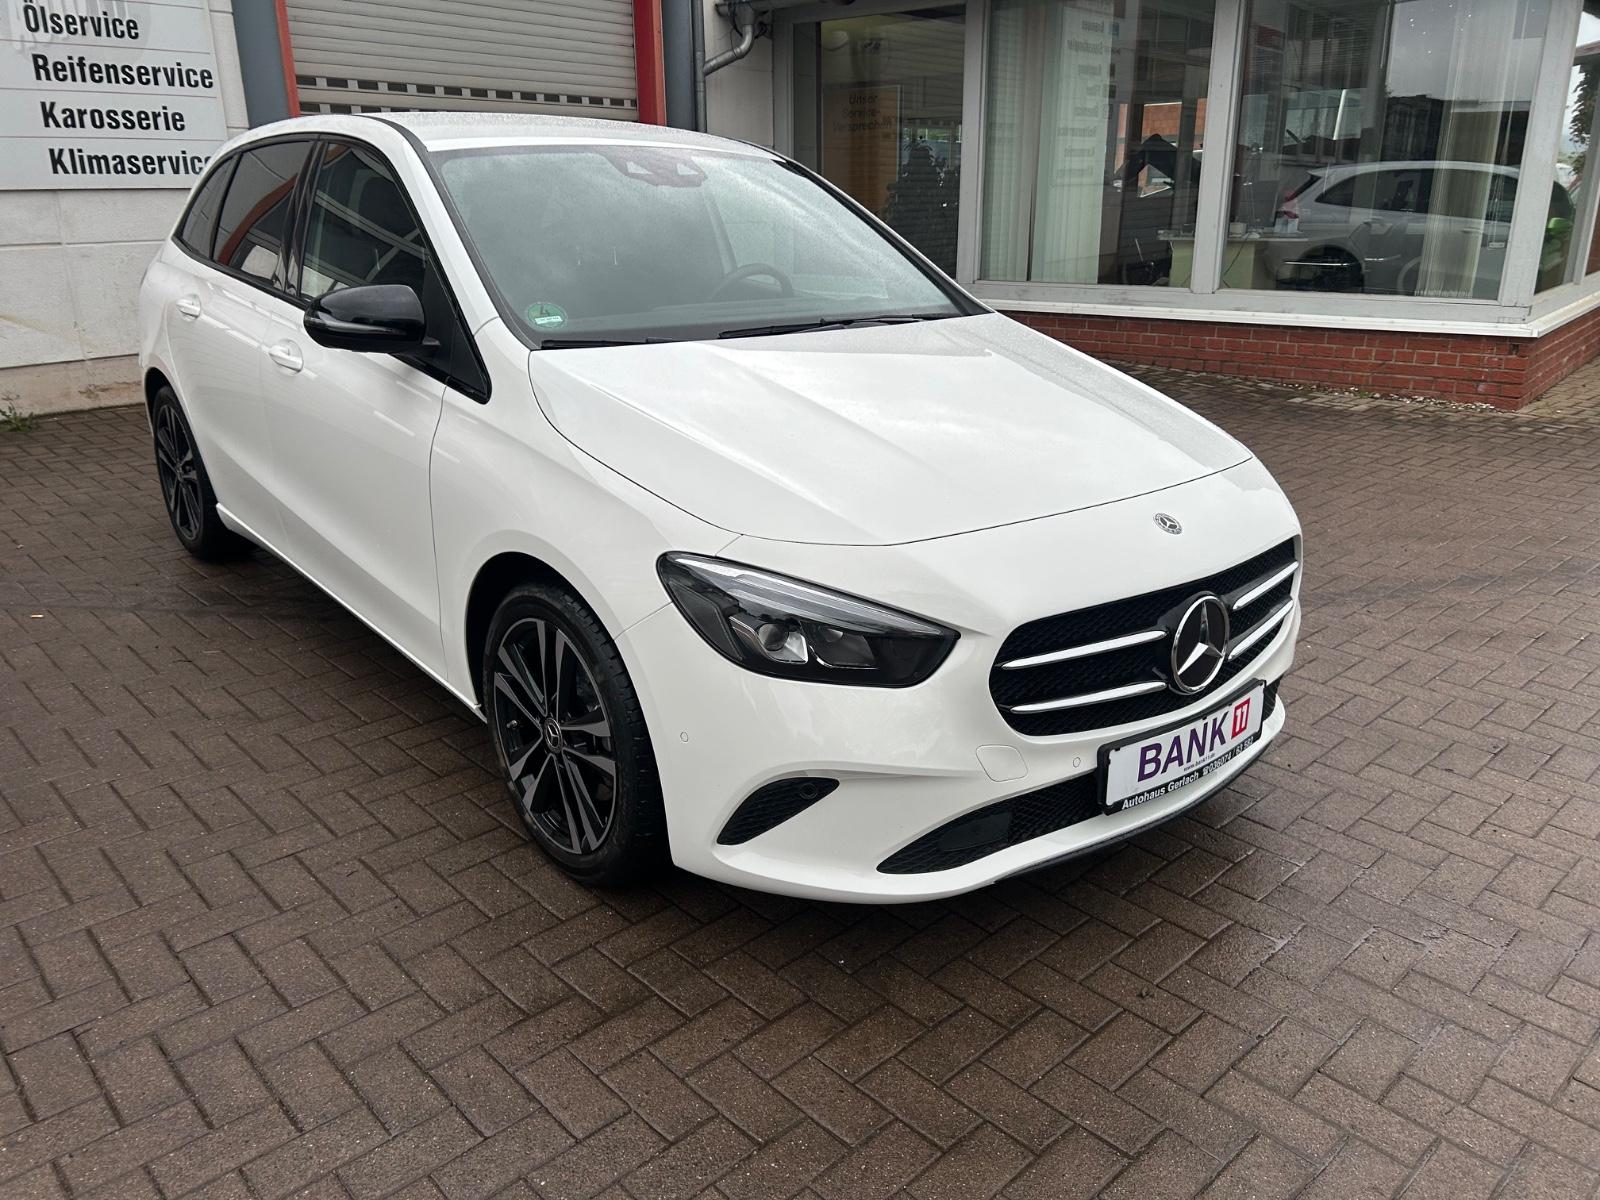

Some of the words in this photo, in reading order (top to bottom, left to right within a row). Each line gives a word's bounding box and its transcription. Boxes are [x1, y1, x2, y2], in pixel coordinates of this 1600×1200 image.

[23, 0, 139, 39] Ölservice
[32, 53, 213, 88] Reifenservice
[40, 100, 185, 131] Karosserie
[1137, 711, 1229, 782] BANK
[1121, 786, 1166, 810] Autohaus
[1167, 772, 1199, 792] Gerlach
